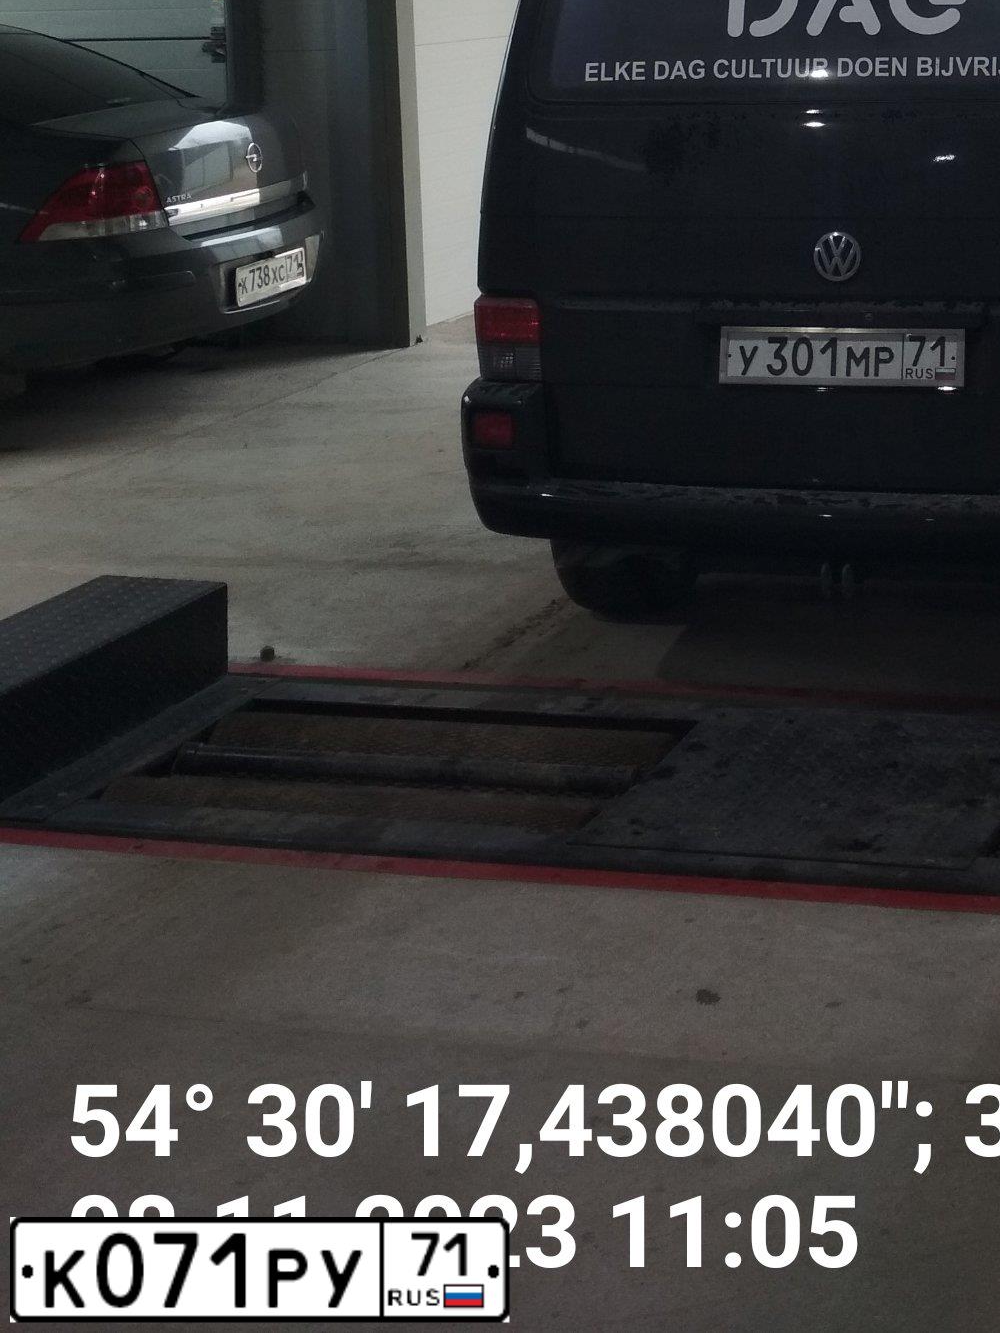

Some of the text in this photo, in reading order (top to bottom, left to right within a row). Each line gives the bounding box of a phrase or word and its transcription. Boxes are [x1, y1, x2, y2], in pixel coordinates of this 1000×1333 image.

[584, 61, 646, 82] ELKE
[653, 59, 706, 80] DAG
[712, 58, 829, 79] CULTUUR
[836, 56, 908, 78] DOEN
[166, 193, 192, 204] ASTRA
[908, 335, 947, 367] 71
[904, 368, 934, 380] RUS
